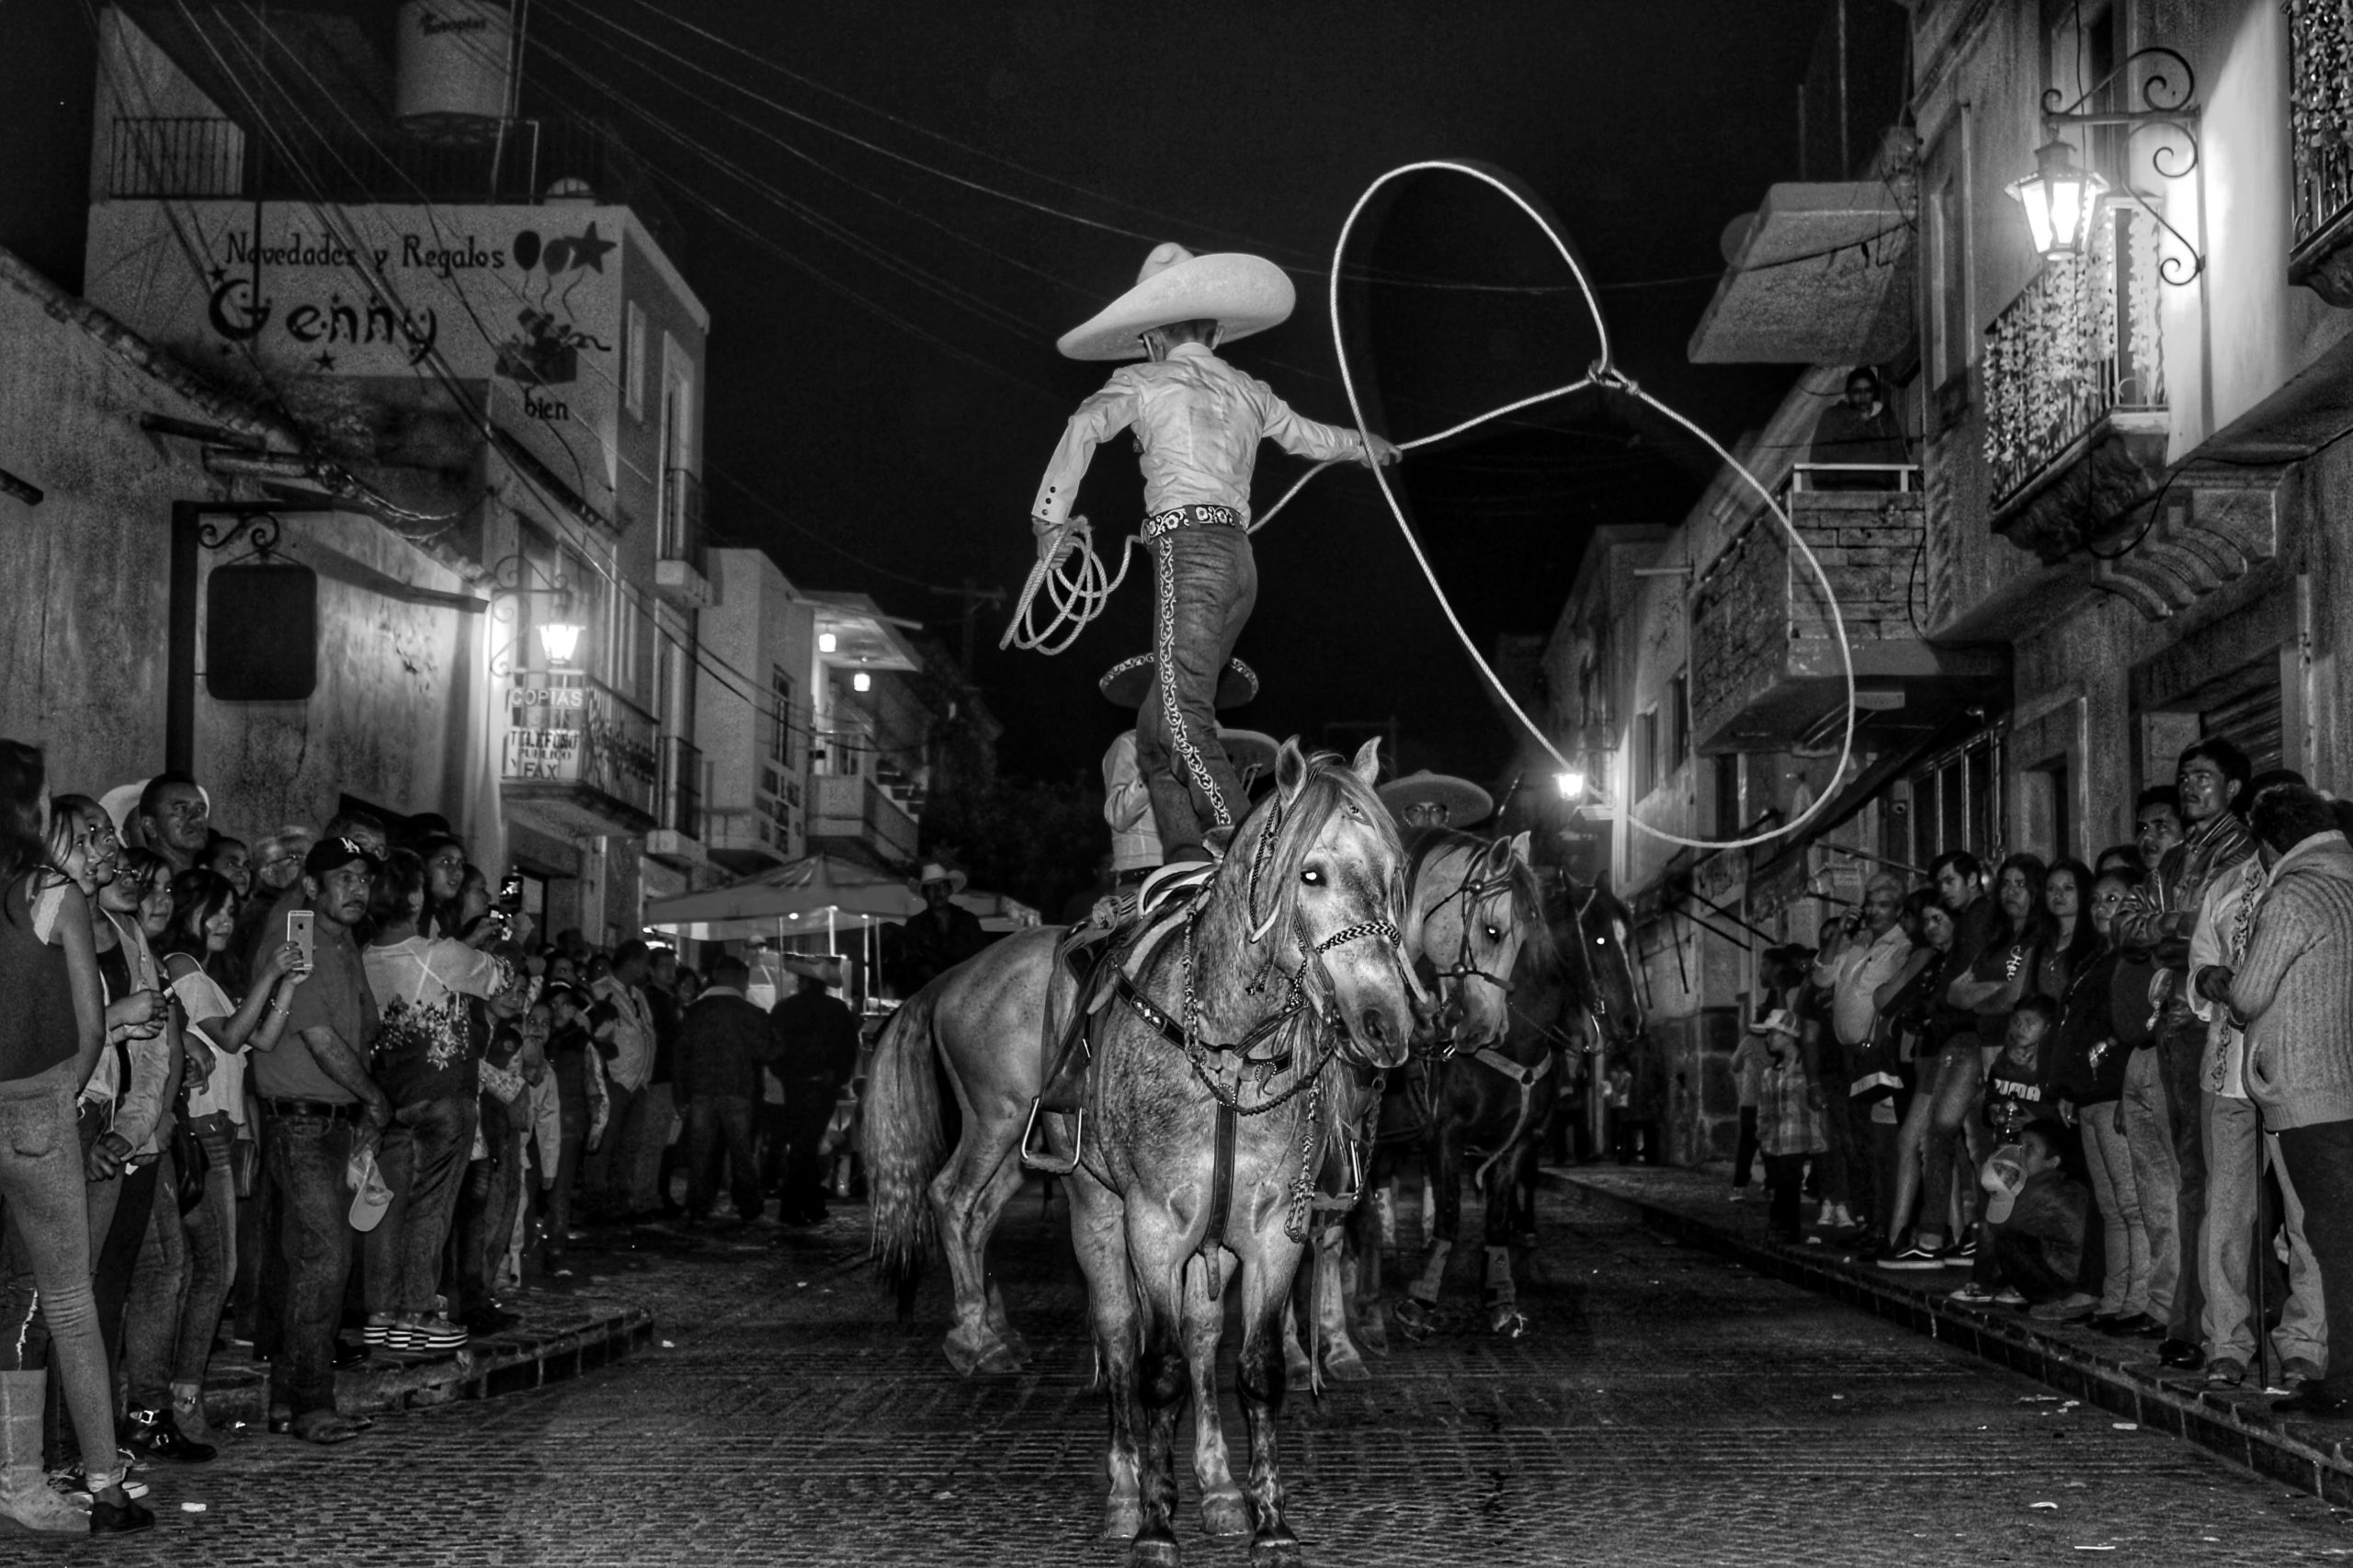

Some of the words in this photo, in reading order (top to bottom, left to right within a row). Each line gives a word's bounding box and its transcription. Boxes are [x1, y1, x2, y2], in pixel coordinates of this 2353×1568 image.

[225, 233, 357, 267] Novedades
[373, 248, 388, 275] y
[403, 234, 505, 278] Regalos
[208, 278, 438, 367] Genny
[524, 385, 568, 420] bien
[511, 689, 583, 707] COPIAS
[524, 762, 558, 780] FAX
[340, 837, 361, 854] LA
